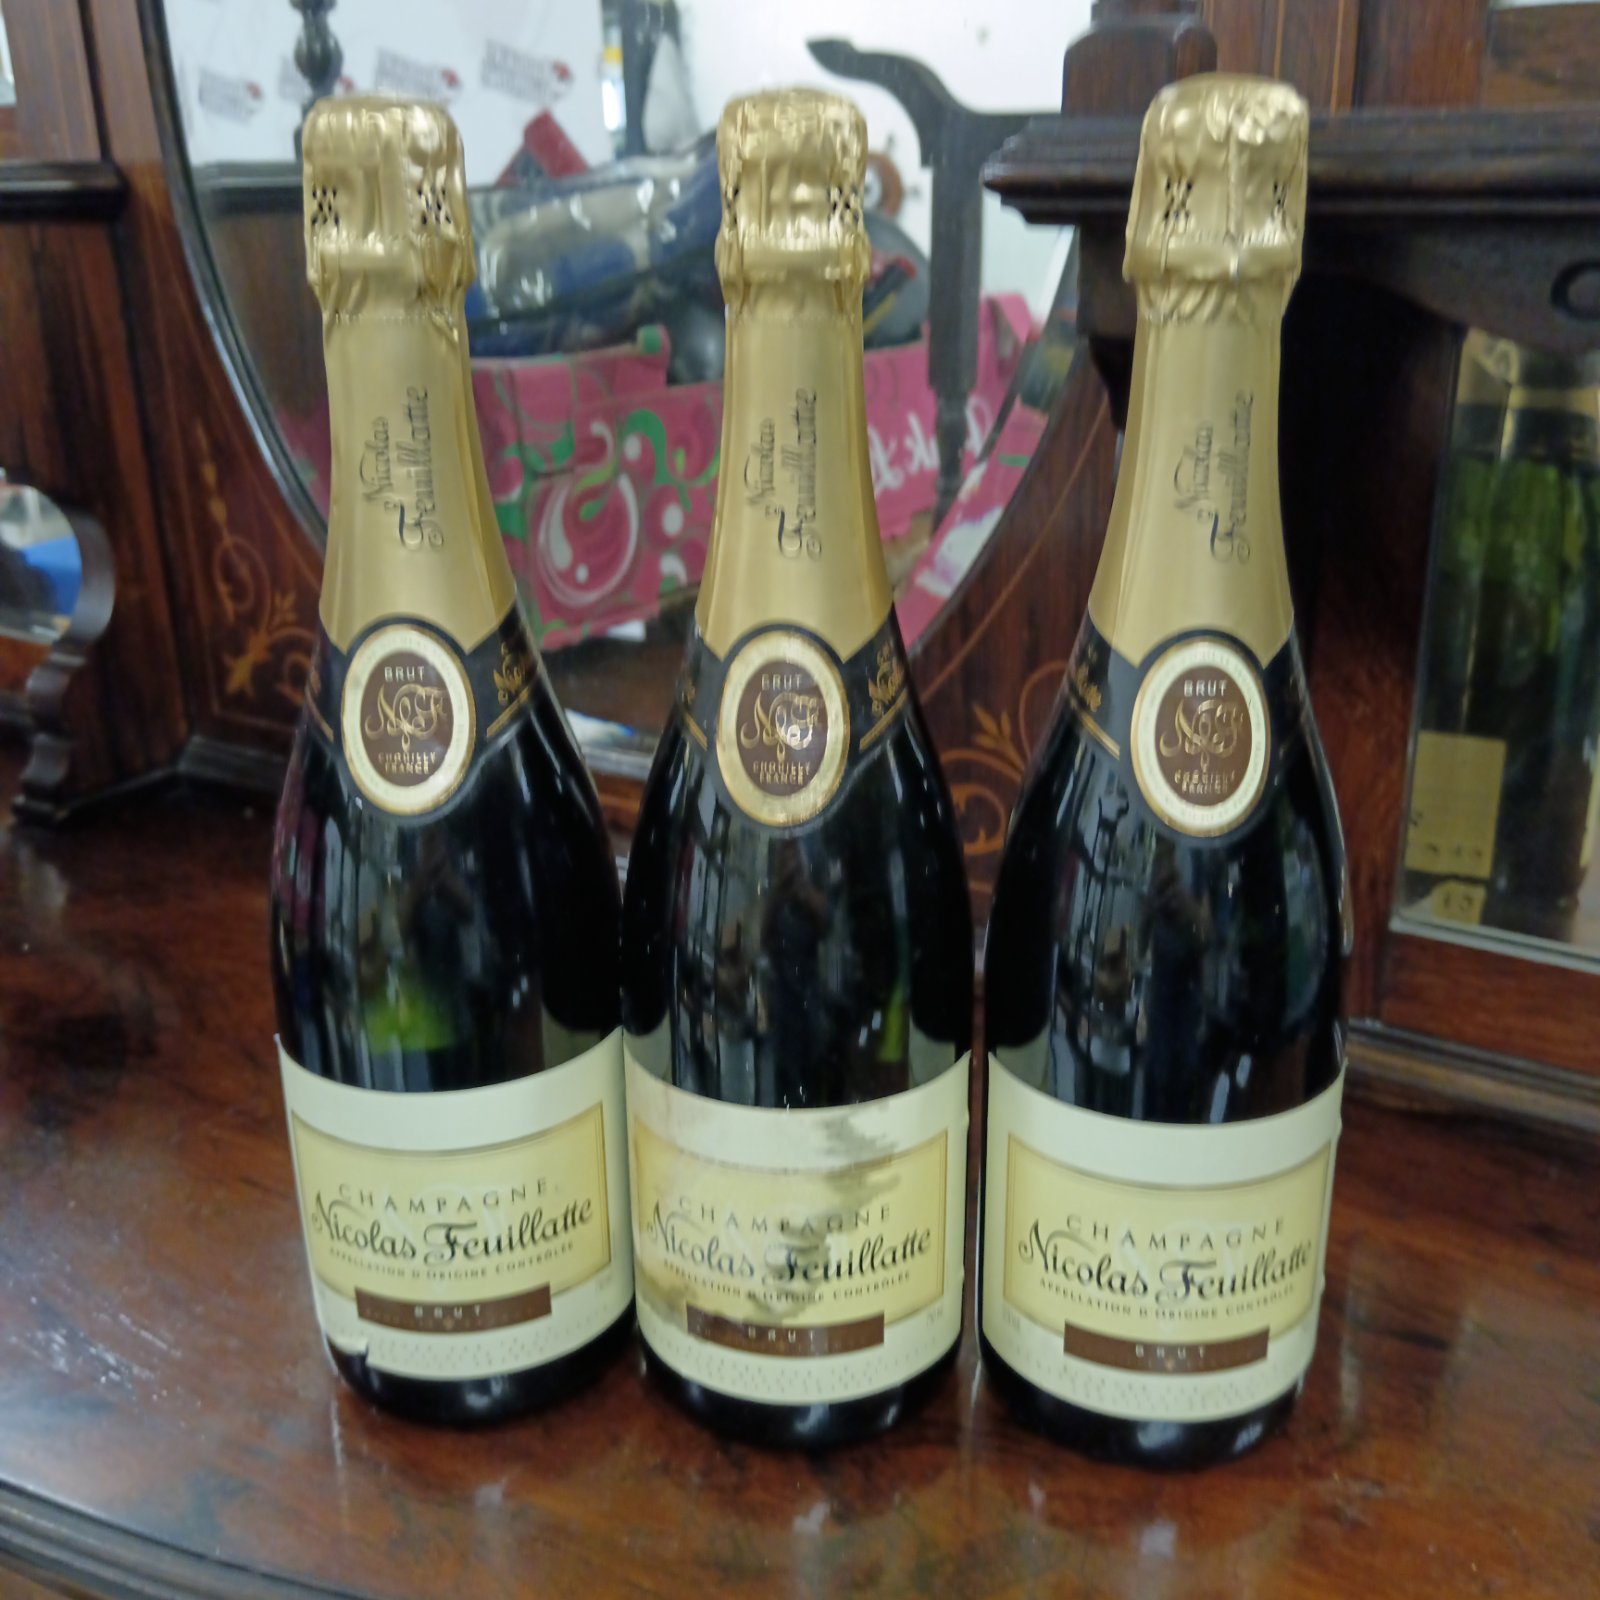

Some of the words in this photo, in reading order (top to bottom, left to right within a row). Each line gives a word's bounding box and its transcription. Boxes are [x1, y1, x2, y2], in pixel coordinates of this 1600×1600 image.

[384, 666, 425, 682] BRUT
[761, 674, 802, 691] BRUT
[1184, 679, 1228, 697] BRUT
[339, 1177, 548, 1214] CHAMPAGNE
[311, 1191, 417, 1259] Nicolas
[423, 1197, 593, 1266] Feuillatte
[680, 1196, 891, 1234] CHAMPAGNE
[1067, 1214, 1284, 1251] CHAMPAGNE
[647, 1200, 755, 1280] Nicolas
[761, 1228, 931, 1287] Feuillatte
[1018, 1218, 1149, 1297] Nicolas
[1155, 1239, 1313, 1306] Feuillatte
